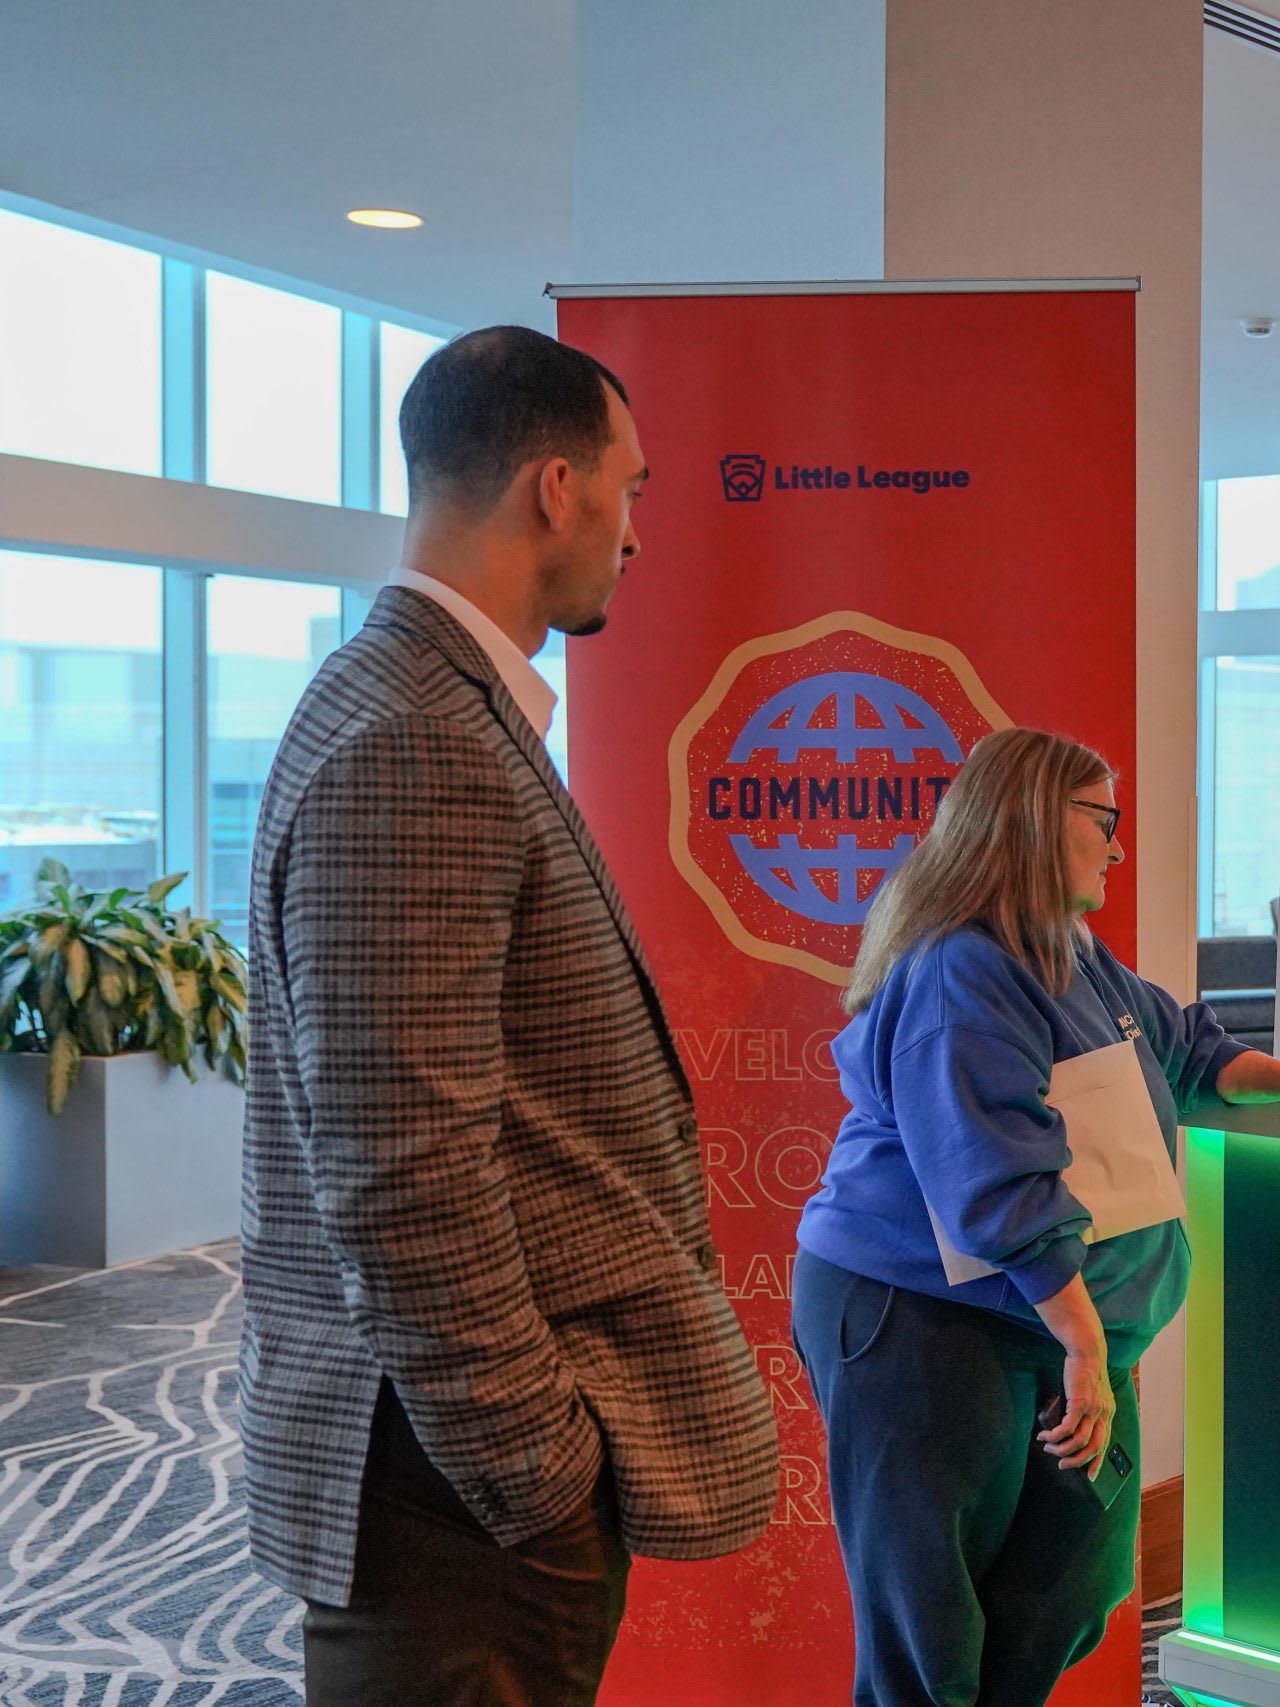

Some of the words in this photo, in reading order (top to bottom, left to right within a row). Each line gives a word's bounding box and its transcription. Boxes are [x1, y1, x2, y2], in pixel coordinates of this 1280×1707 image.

[774, 466, 851, 490] Little
[858, 465, 970, 494] League
[708, 776, 952, 820] COMMUNIT
[672, 1028, 842, 1083] VELO
[716, 1254, 797, 1300] LA
